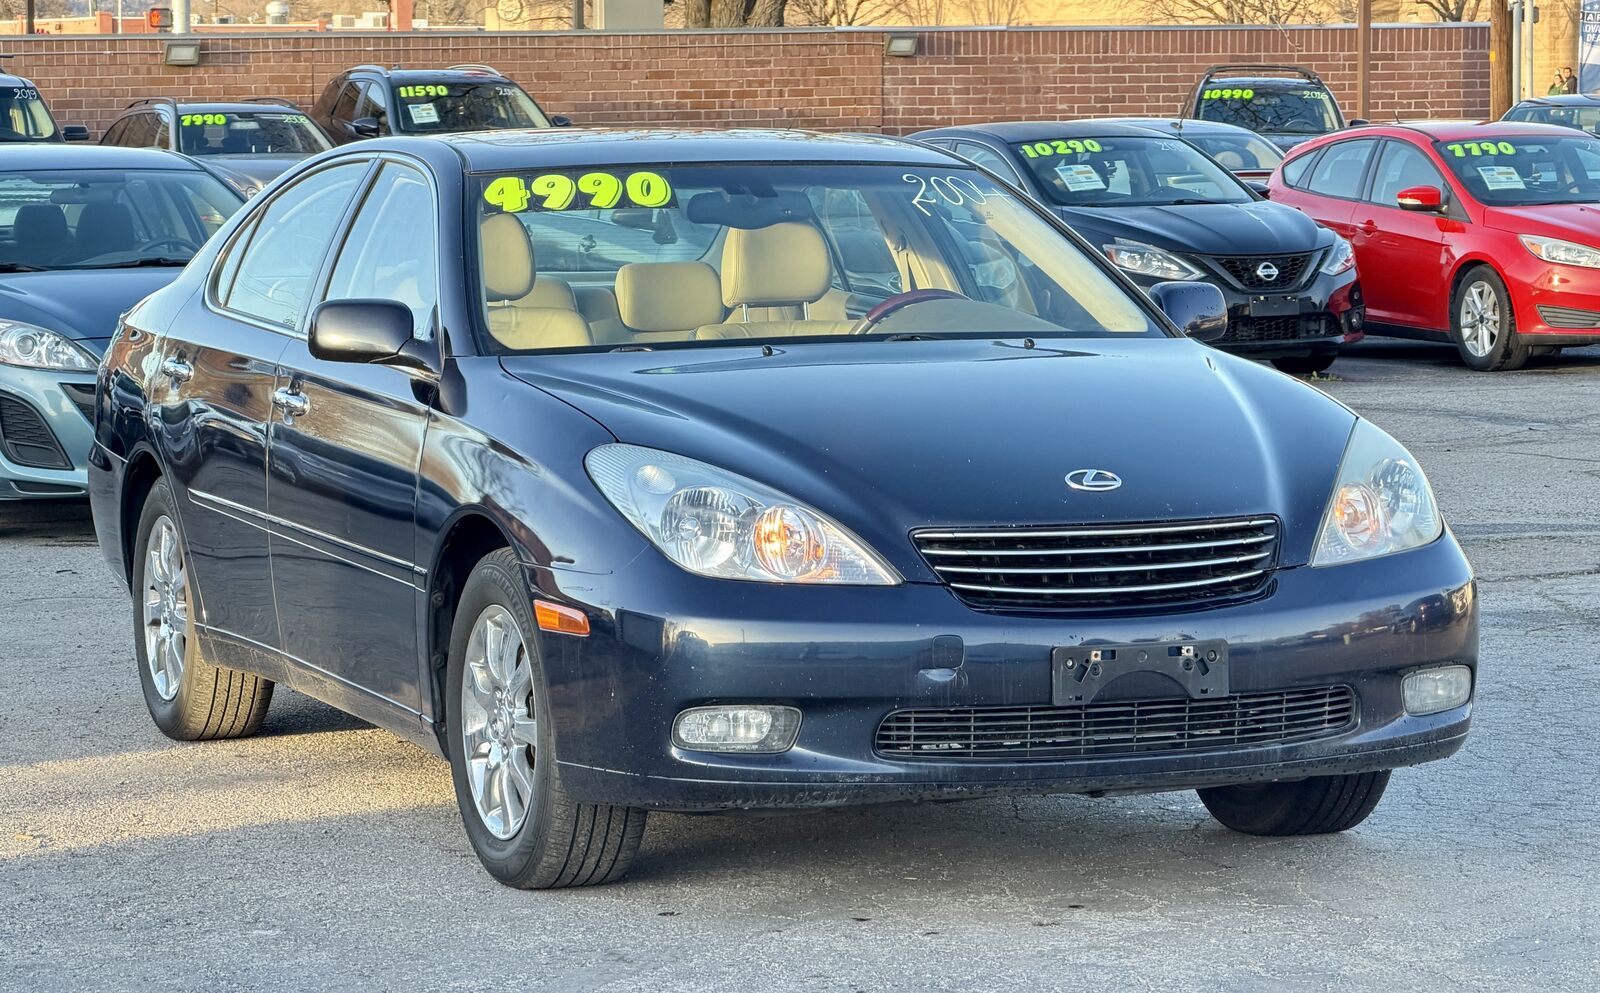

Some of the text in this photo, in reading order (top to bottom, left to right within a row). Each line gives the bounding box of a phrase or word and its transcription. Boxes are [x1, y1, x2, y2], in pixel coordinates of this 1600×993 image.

[13, 88, 37, 100] 2019
[399, 85, 448, 97] 11590
[1203, 89, 1254, 99] 10990
[1303, 91, 1329, 100] 2016
[181, 114, 226, 126] 7990
[1022, 139, 1102, 158] 10290
[1447, 141, 1516, 157] 7790
[484, 171, 672, 212] 4990
